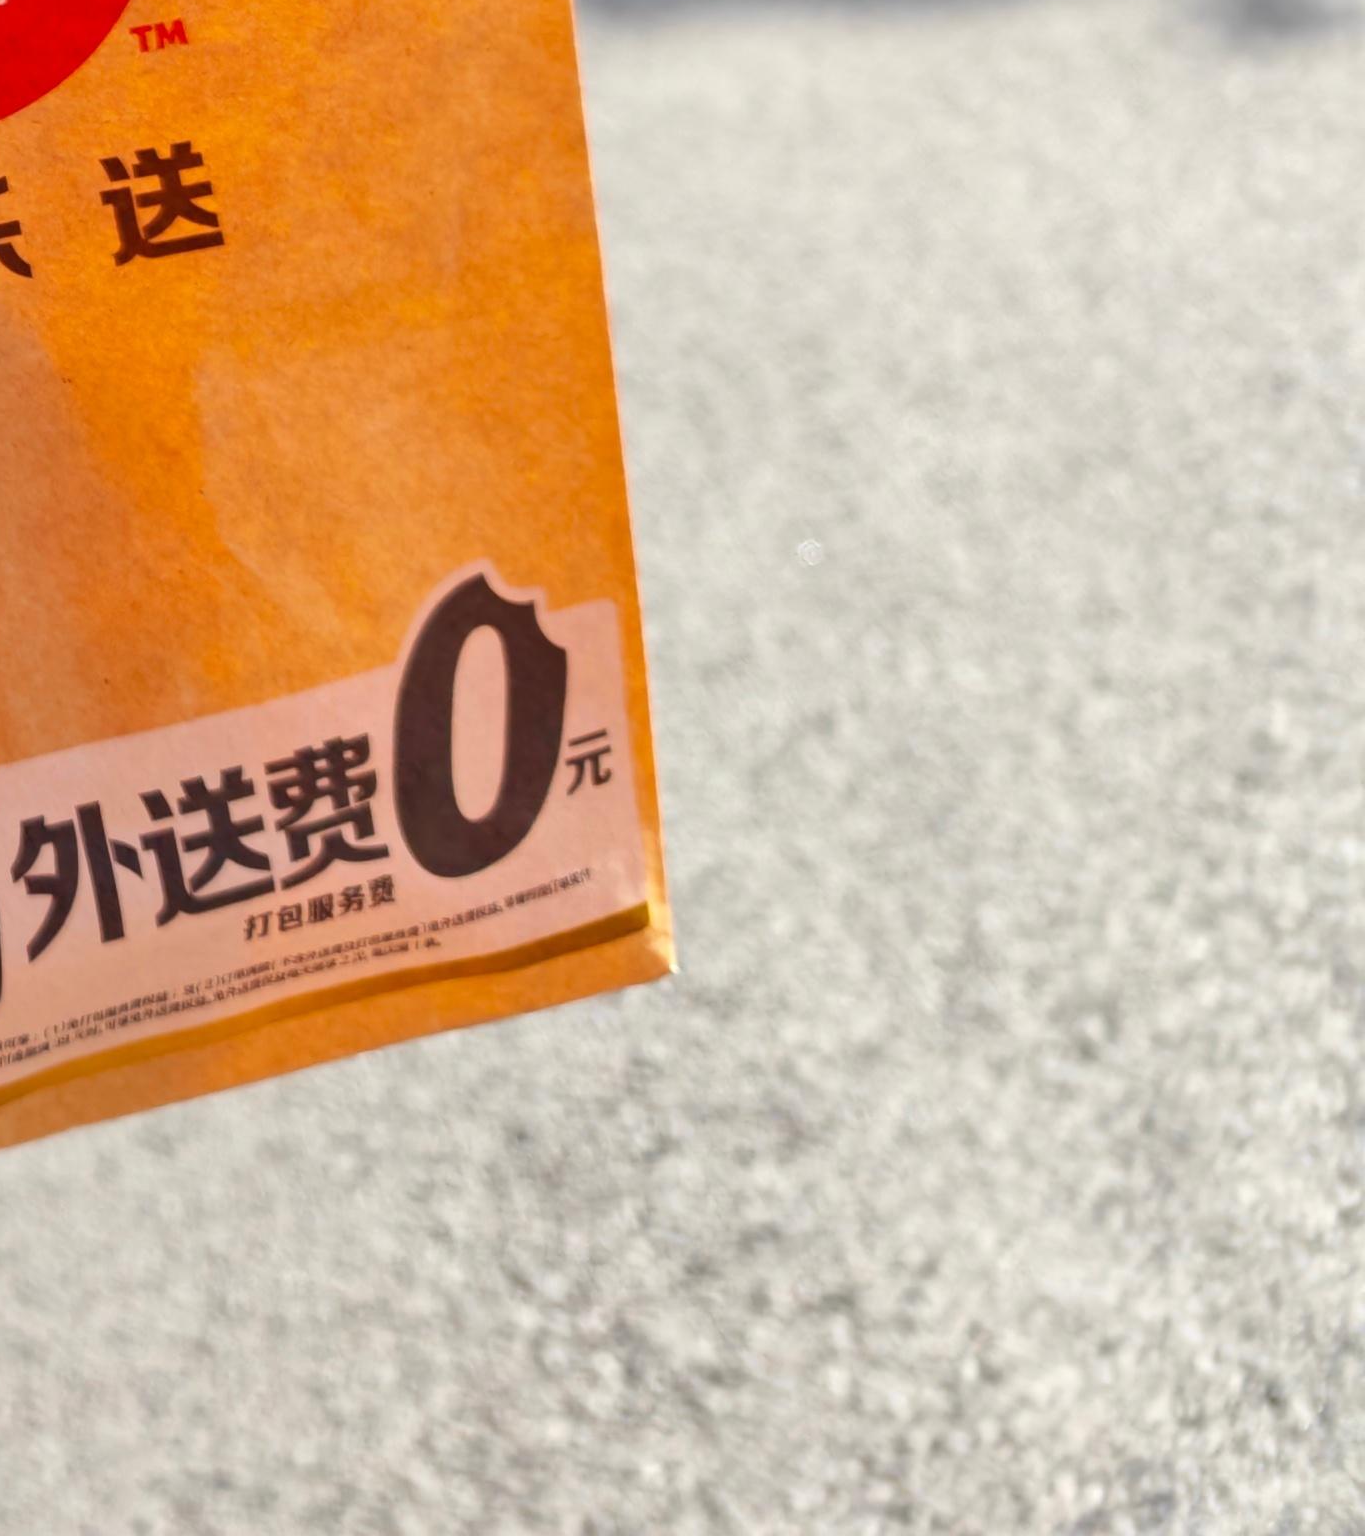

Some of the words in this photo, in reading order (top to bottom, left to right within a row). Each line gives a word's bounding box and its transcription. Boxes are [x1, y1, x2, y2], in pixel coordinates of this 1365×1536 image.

[129, 19, 189, 53] TM
[243, 874, 395, 941] 打包服务费
